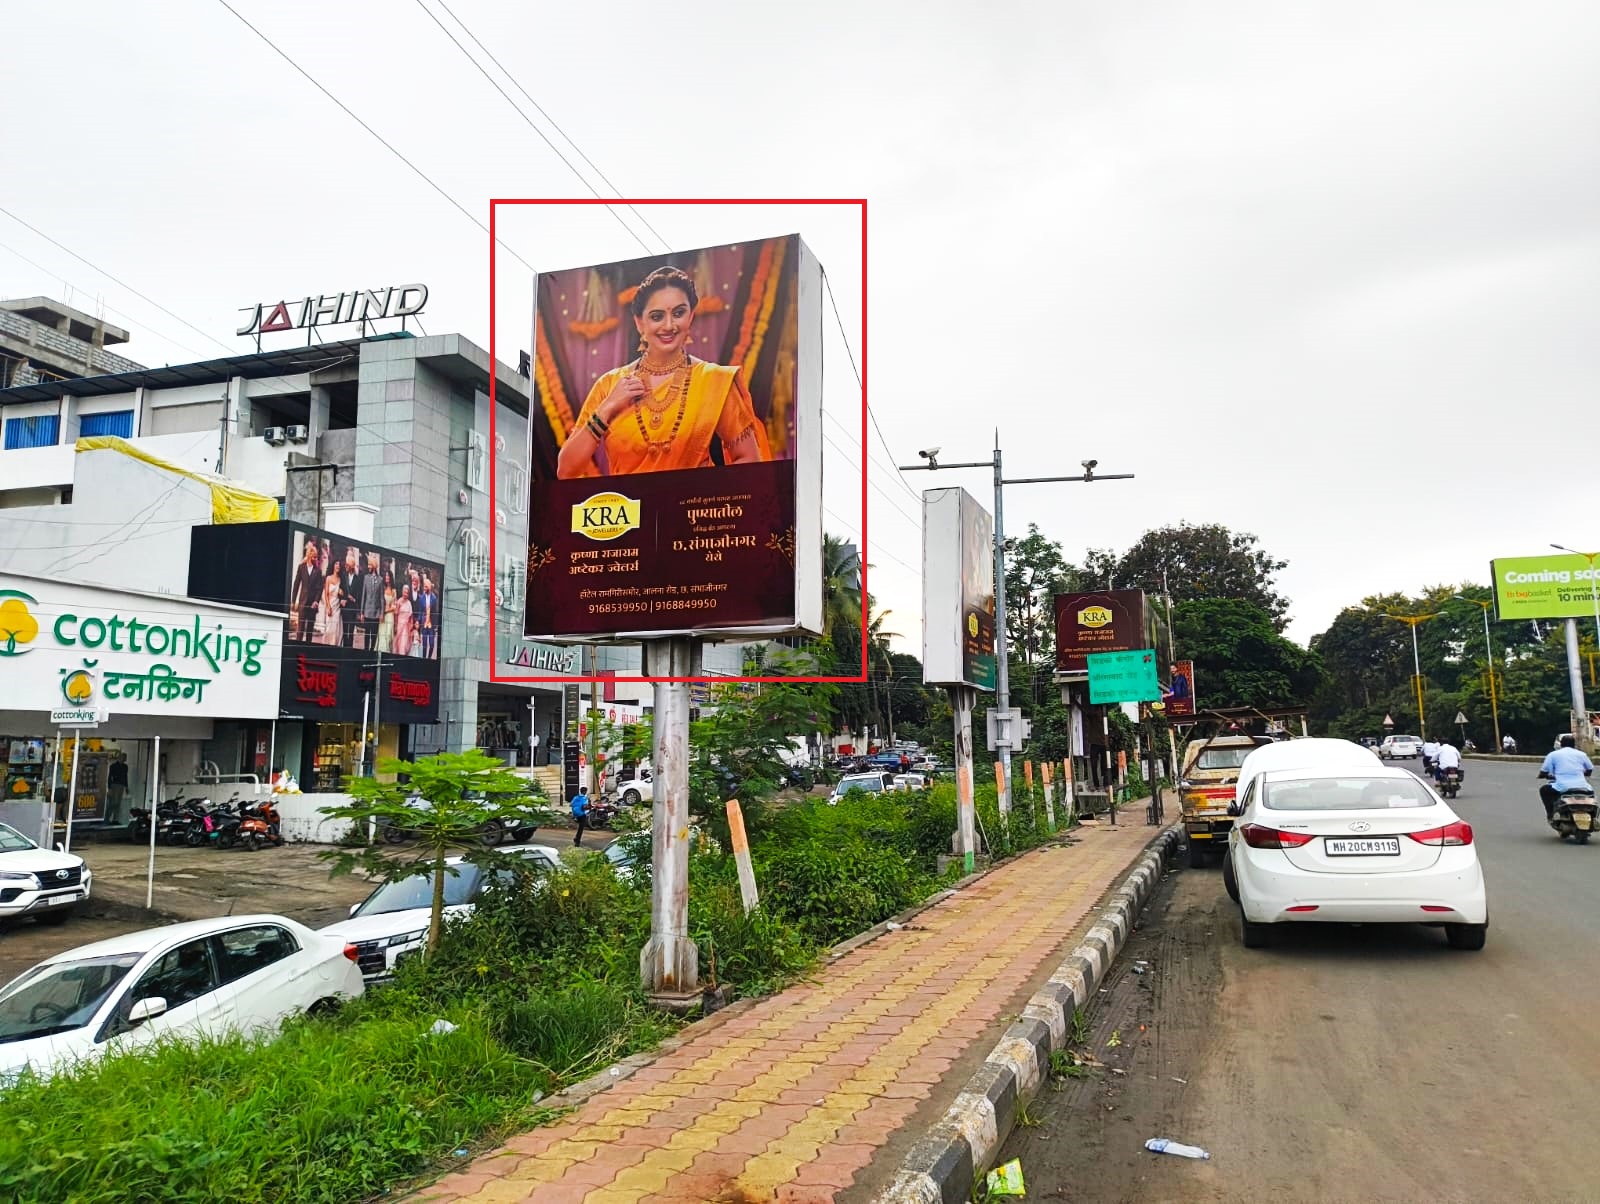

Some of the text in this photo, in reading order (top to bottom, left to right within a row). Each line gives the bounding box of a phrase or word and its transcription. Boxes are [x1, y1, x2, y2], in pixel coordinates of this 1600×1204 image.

[236, 283, 429, 336] JAIHIND
[582, 505, 631, 528] KRA
[687, 504, 743, 525] पुण्यातील
[570, 550, 599, 564] कृष्णा
[569, 560, 639, 575] अष्टेकर ज्वेलर्स
[1504, 569, 1571, 584] Coming
[1557, 593, 1571, 602] 10
[588, 598, 717, 614] 9168539950 9168849950
[1083, 611, 1107, 623] KRA
[53, 613, 267, 677] cottonking
[59, 657, 212, 704] टनकिंग
[52, 709, 95, 721] cottonking
